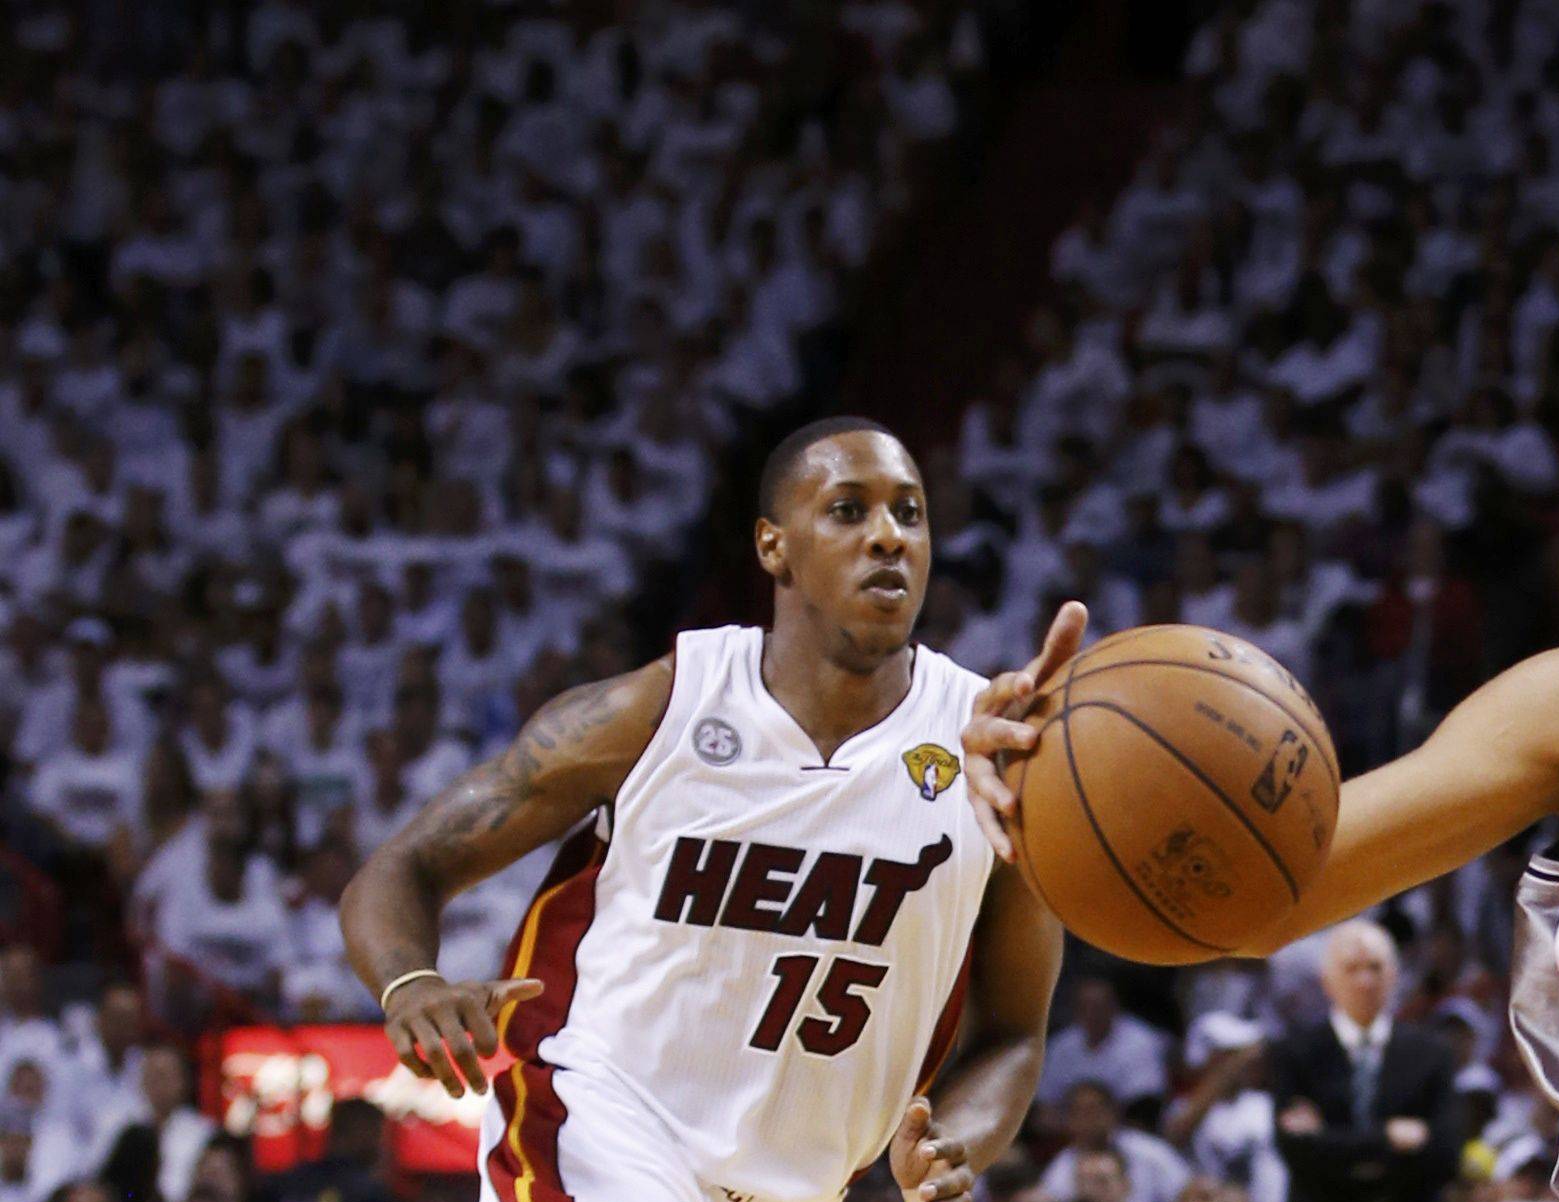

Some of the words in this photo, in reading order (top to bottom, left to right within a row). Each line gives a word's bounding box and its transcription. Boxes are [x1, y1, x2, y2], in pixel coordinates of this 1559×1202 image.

[699, 724, 733, 757] 25
[652, 833, 954, 947] HEAT
[746, 952, 890, 1058] 15
